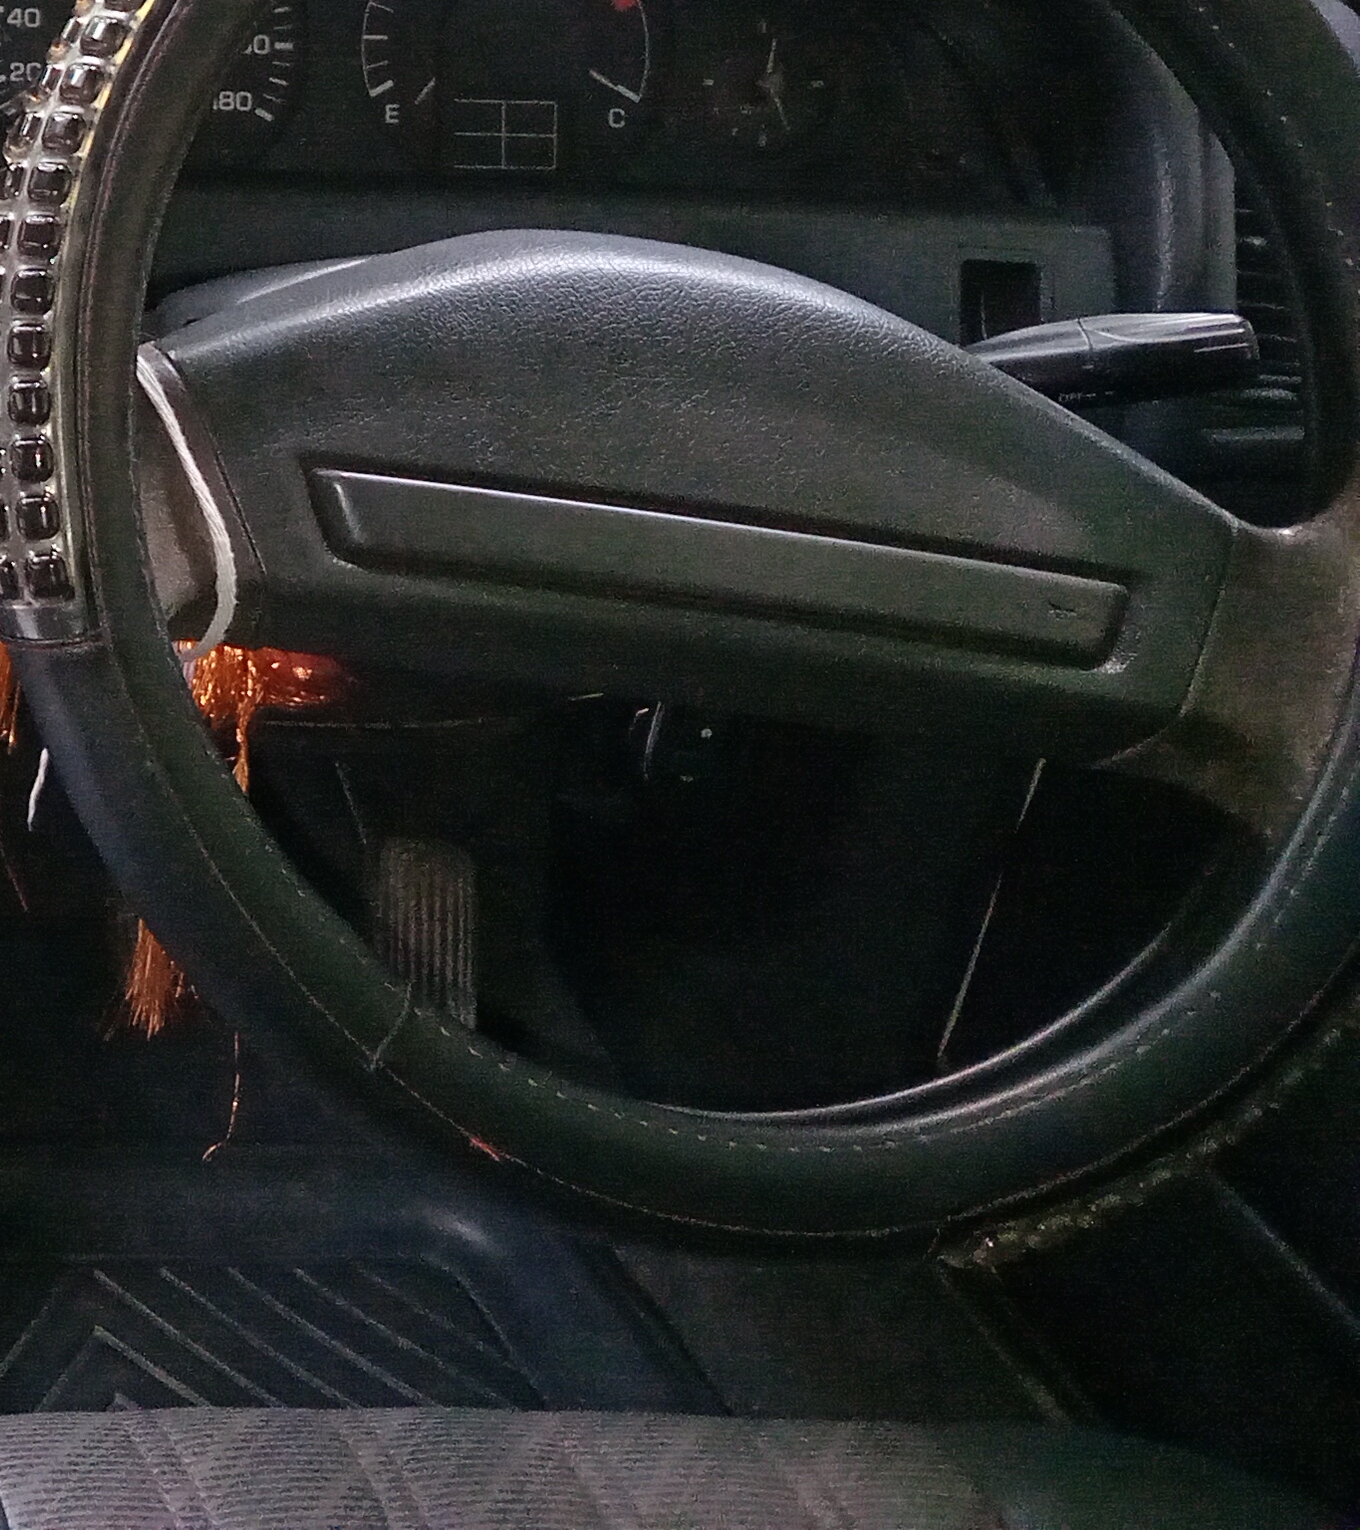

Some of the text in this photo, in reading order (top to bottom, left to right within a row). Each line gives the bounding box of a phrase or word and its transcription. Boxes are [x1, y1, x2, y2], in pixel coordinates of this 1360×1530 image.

[6, 7, 41, 29] 40
[385, 104, 400, 124] E
[609, 108, 626, 128] C
